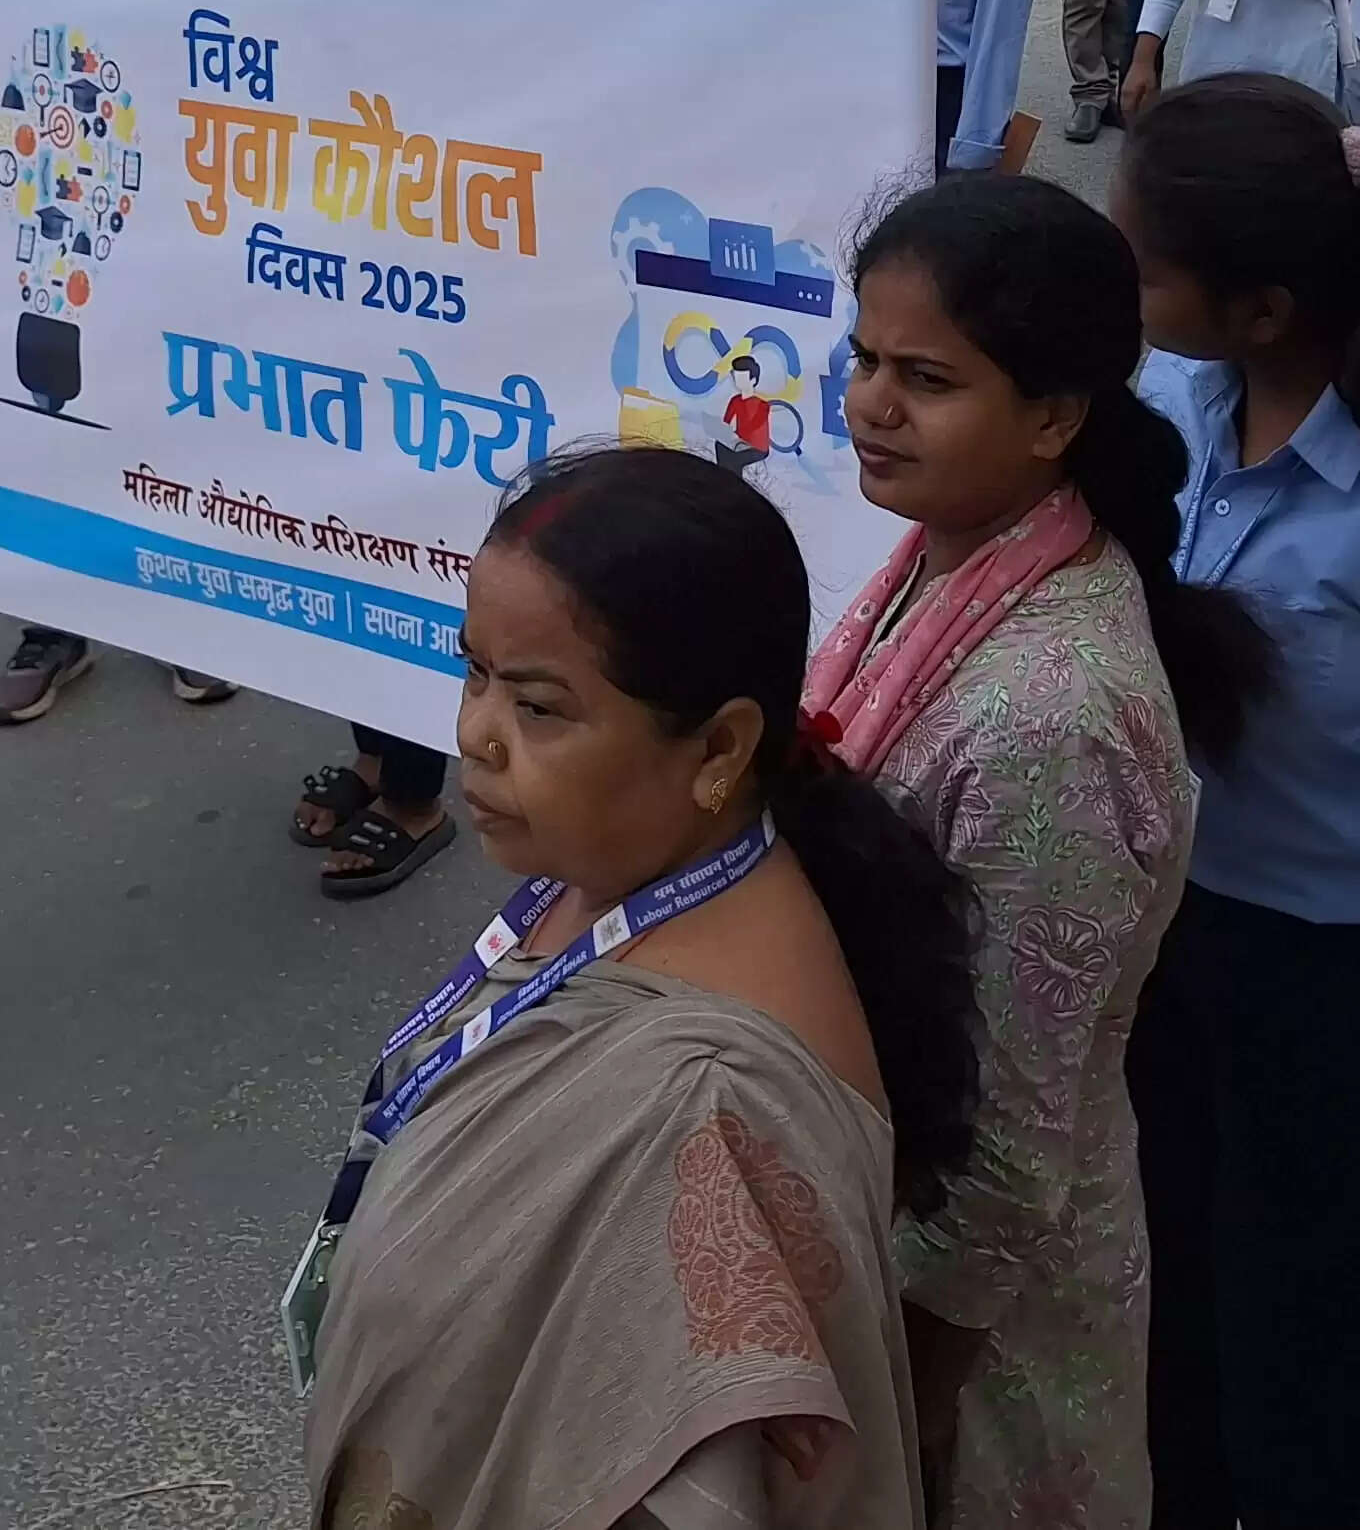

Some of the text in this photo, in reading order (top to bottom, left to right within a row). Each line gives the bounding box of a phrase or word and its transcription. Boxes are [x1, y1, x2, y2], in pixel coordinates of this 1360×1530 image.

[182, 8, 279, 102] विश्व
[178, 89, 543, 258] युवा कौशल
[245, 222, 467, 324] दिवस 2025
[161, 331, 556, 489] प्रभात फेरी
[122, 462, 193, 516] महिला
[198, 478, 306, 548] औद्योगिक
[310, 514, 420, 574] प्रशिक्षण
[134, 546, 192, 584] कुशल
[193, 562, 233, 599] युवा
[234, 571, 294, 616] समृद्ध
[295, 586, 335, 626] युवा
[362, 602, 425, 647] सपना
[636, 903, 673, 926] Labour
[674, 877, 727, 909] Resources
[428, 973, 476, 1022] Department
